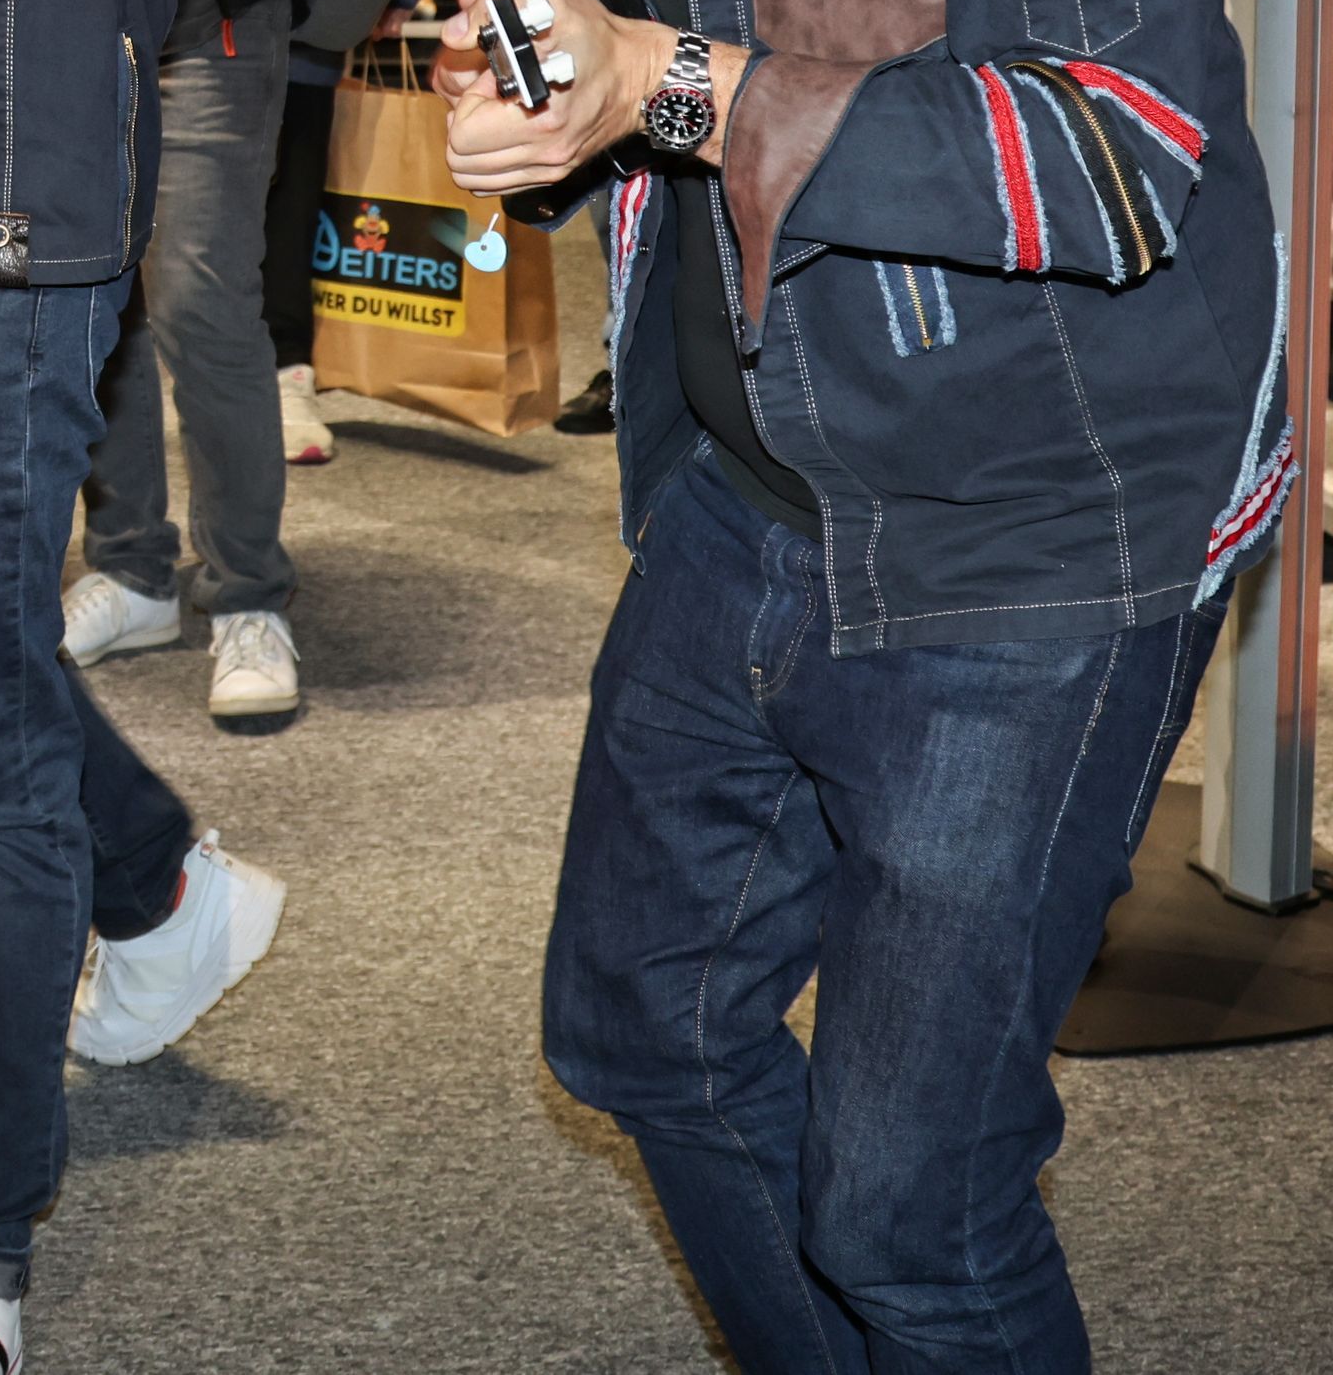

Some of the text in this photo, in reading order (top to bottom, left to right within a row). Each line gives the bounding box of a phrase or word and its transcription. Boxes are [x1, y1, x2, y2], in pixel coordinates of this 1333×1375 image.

[311, 209, 458, 291] DEITERS
[352, 296, 382, 316] DU
[386, 300, 456, 328] WILLST
